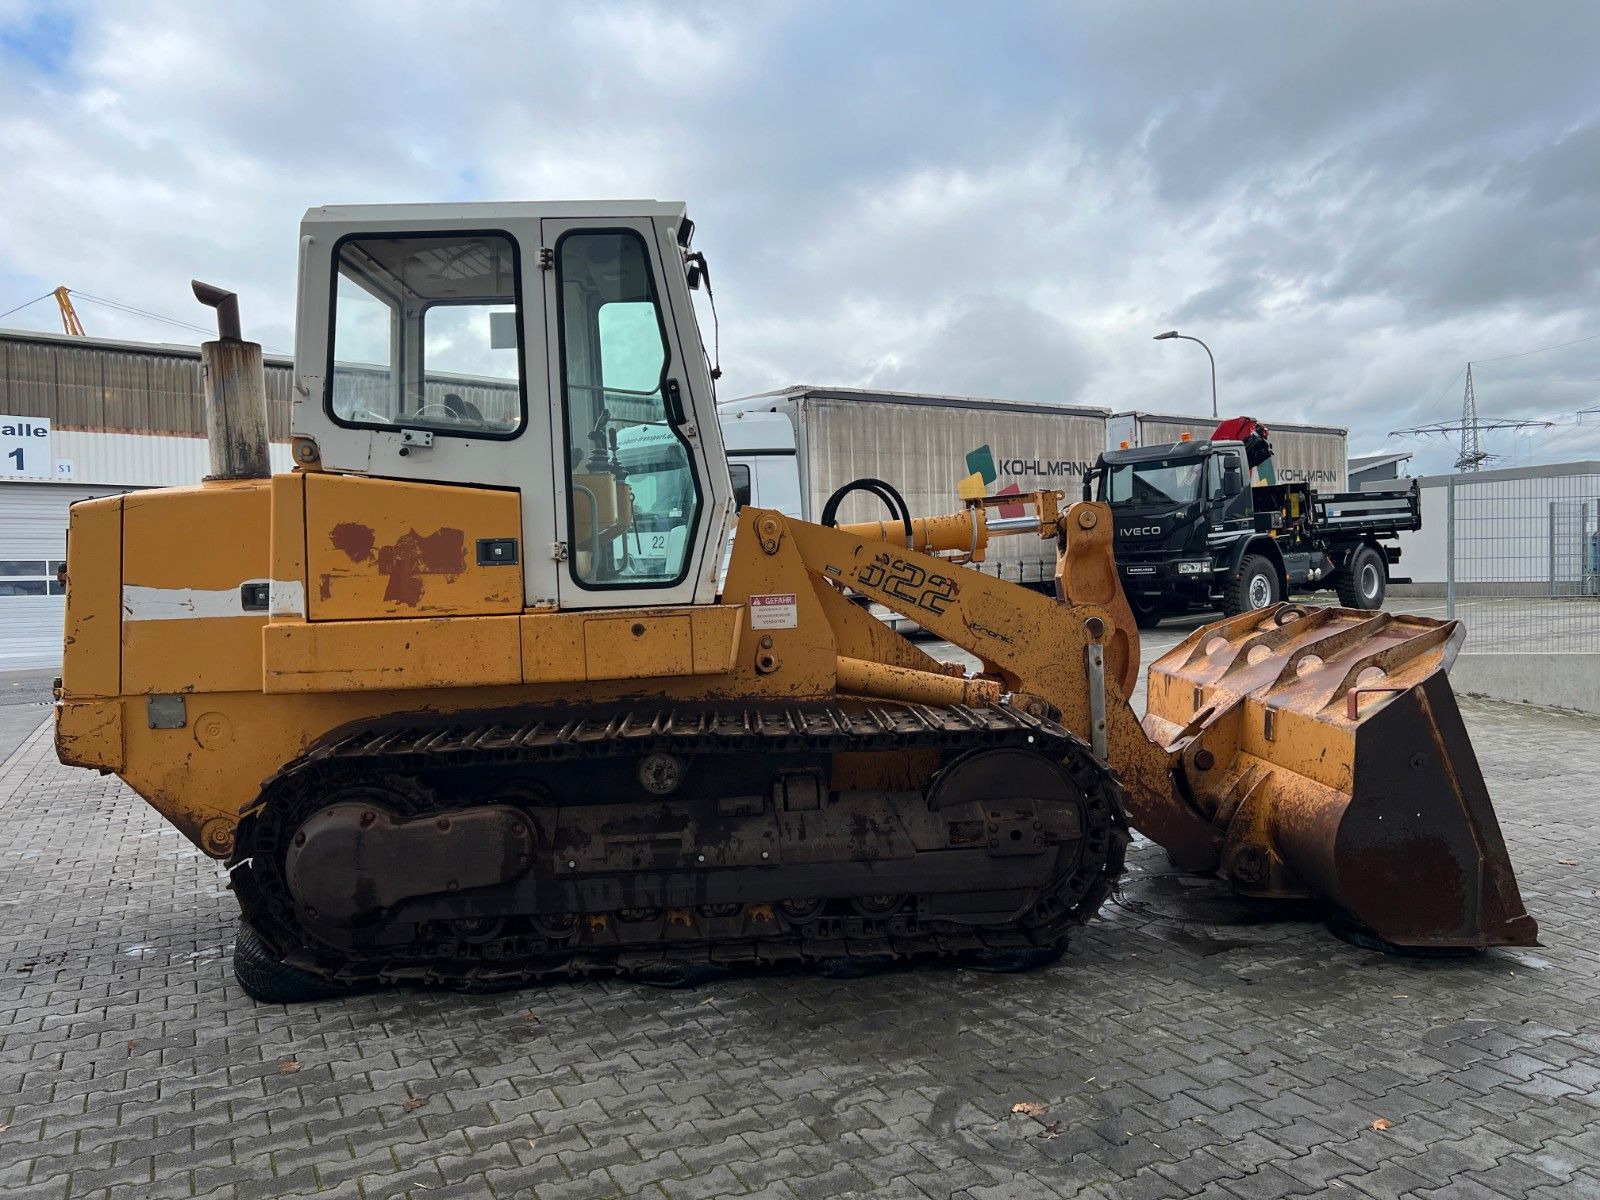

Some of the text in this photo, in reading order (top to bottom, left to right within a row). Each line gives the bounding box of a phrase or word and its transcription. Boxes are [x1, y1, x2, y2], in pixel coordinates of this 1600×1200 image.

[1, 423, 48, 437] alle
[8, 447, 24, 470] 1
[999, 459, 1092, 476] KOHLMANN
[1277, 468, 1337, 482] KOHLMANN
[1119, 526, 1161, 537] IVECO
[652, 535, 665, 549] 22
[765, 597, 792, 605] GEFAHR
